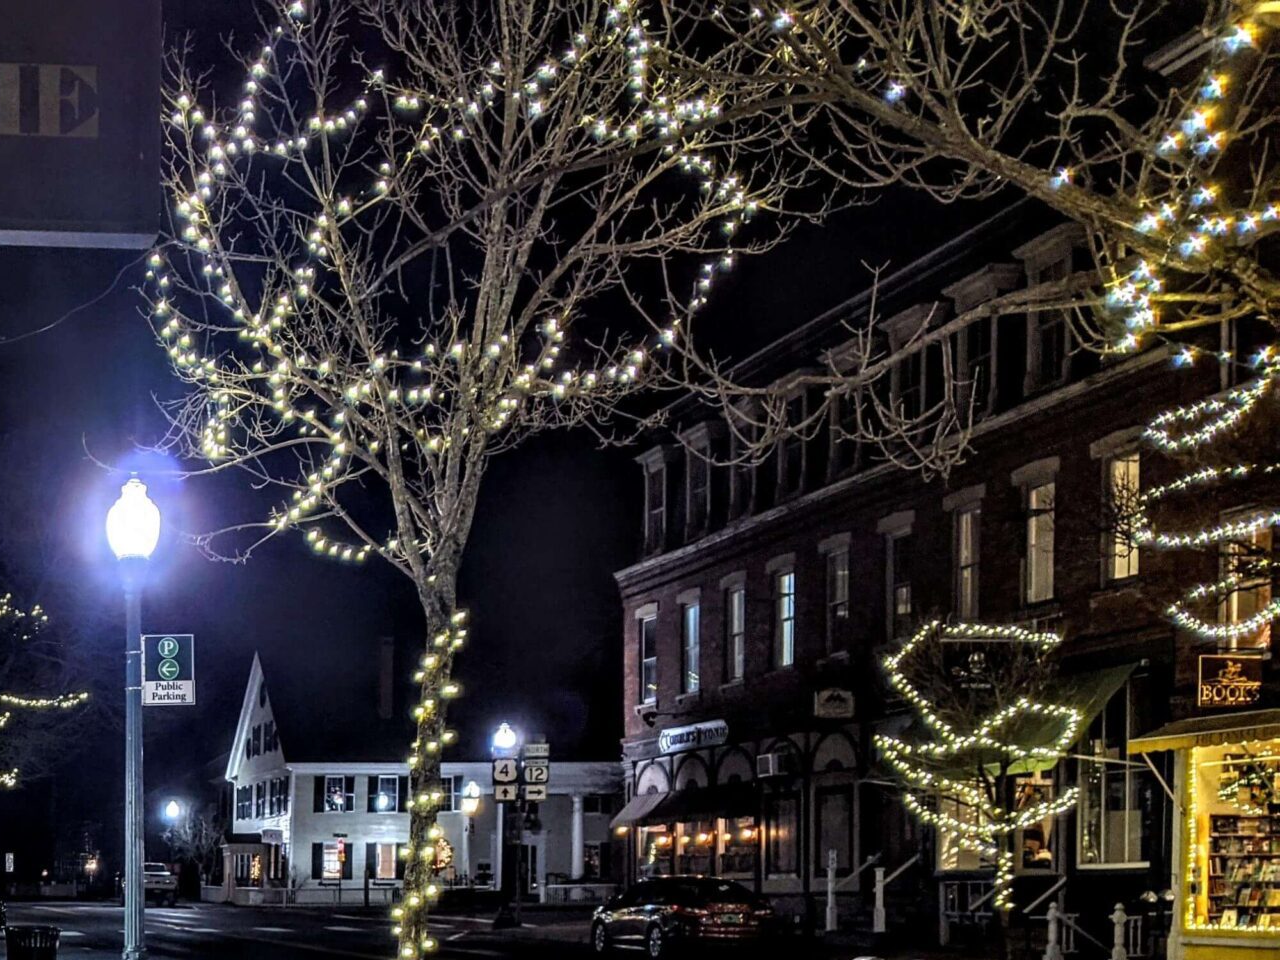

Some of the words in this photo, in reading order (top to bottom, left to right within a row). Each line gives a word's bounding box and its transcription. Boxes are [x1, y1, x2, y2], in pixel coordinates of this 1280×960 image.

[163, 640, 174, 655] P
[154, 681, 184, 691] Public
[1201, 684, 1260, 701] BOOKS
[151, 692, 187, 703] Parking
[499, 763, 510, 777] 4
[528, 767, 544, 781] 12
